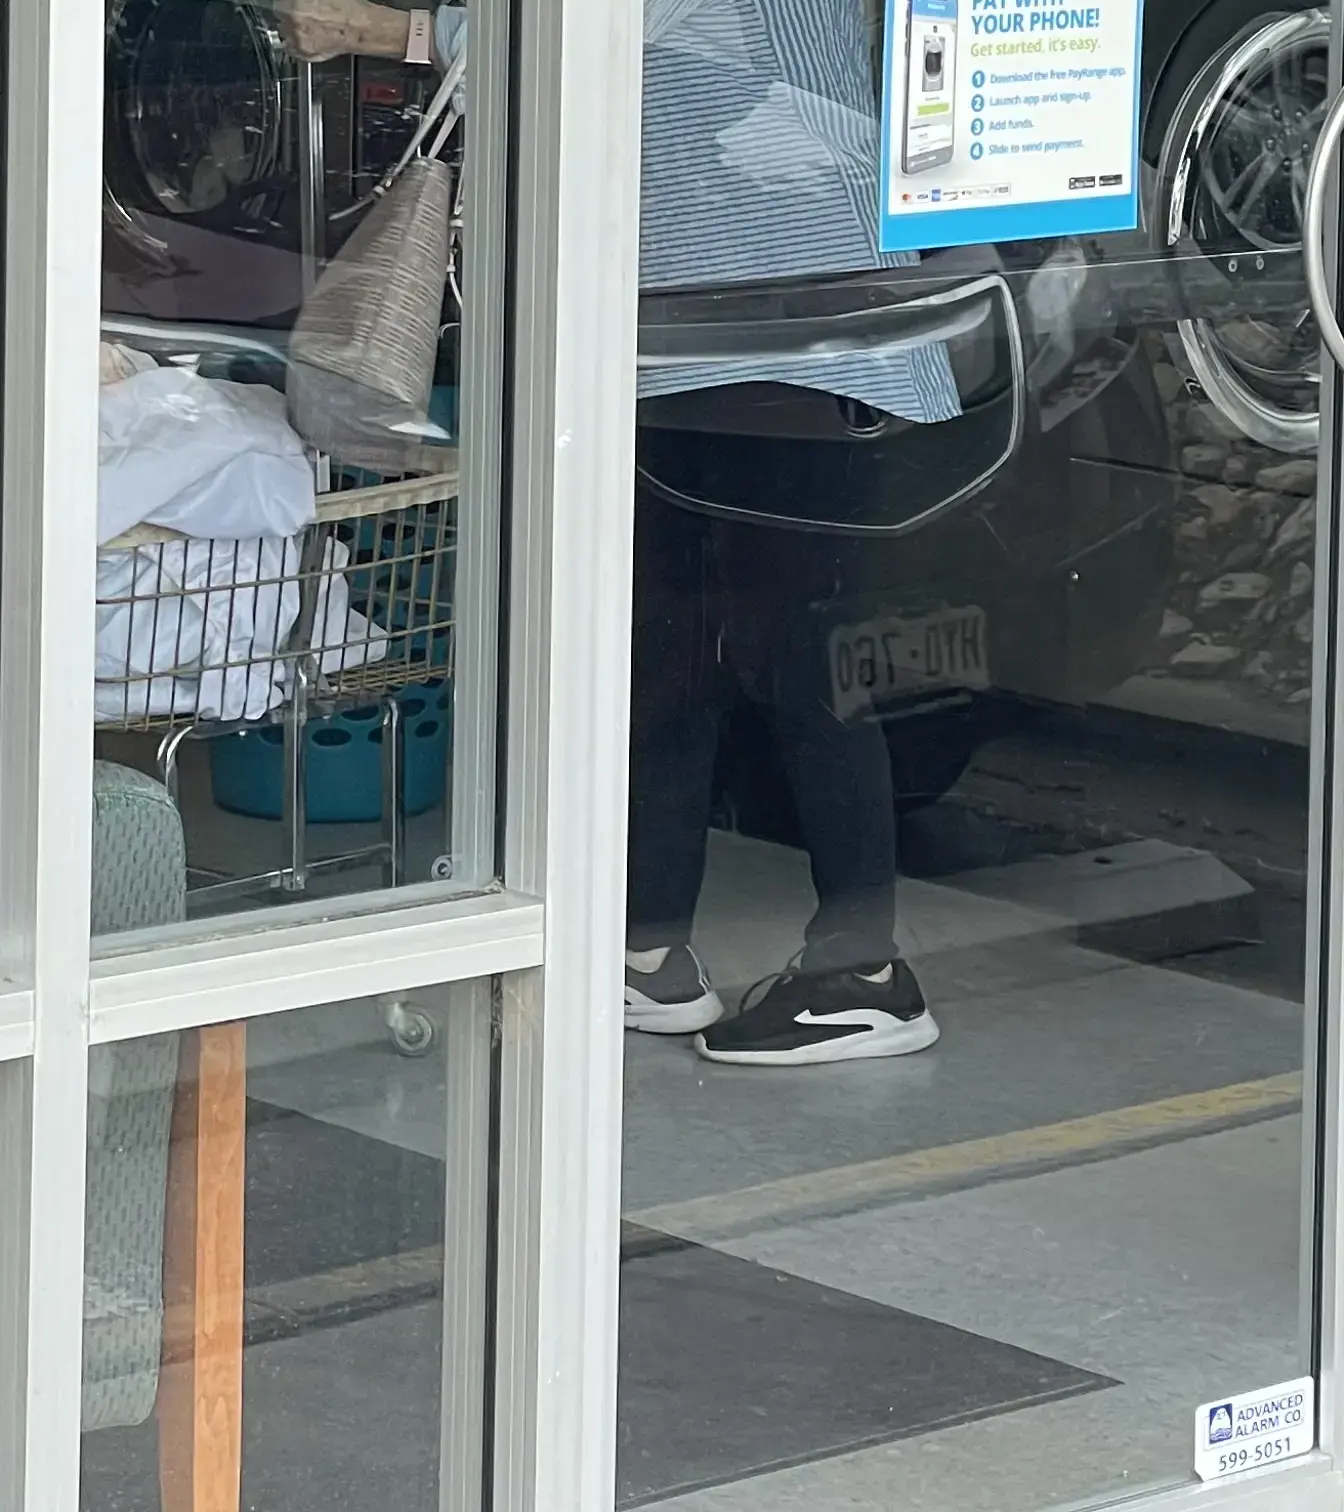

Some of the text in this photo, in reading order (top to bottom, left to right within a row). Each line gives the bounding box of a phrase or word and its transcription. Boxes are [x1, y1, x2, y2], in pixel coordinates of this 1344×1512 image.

[971, 8, 1100, 35] YOUR PHONE!
[970, 42, 992, 57] Get
[1049, 37, 1067, 52] it's
[1069, 36, 1101, 53] easy.
[990, 71, 1033, 84] Download
[1034, 71, 1048, 82] the
[1050, 69, 1067, 80] free
[1068, 67, 1108, 80] PayRange
[1109, 66, 1126, 78] app.
[989, 95, 1021, 107] Launch
[1023, 96, 1040, 106] app
[1041, 92, 1058, 102] and
[988, 120, 1007, 131] Add
[1008, 118, 1034, 129] funds.
[988, 143, 1009, 155] Slide
[1010, 143, 1020, 153] to
[1021, 141, 1042, 152] send
[1044, 139, 1084, 153] payment.
[1237, 1394, 1303, 1421] ADVANCED
[1236, 1416, 1279, 1437] ALARM
[1219, 1437, 1291, 1471] 599-5051
